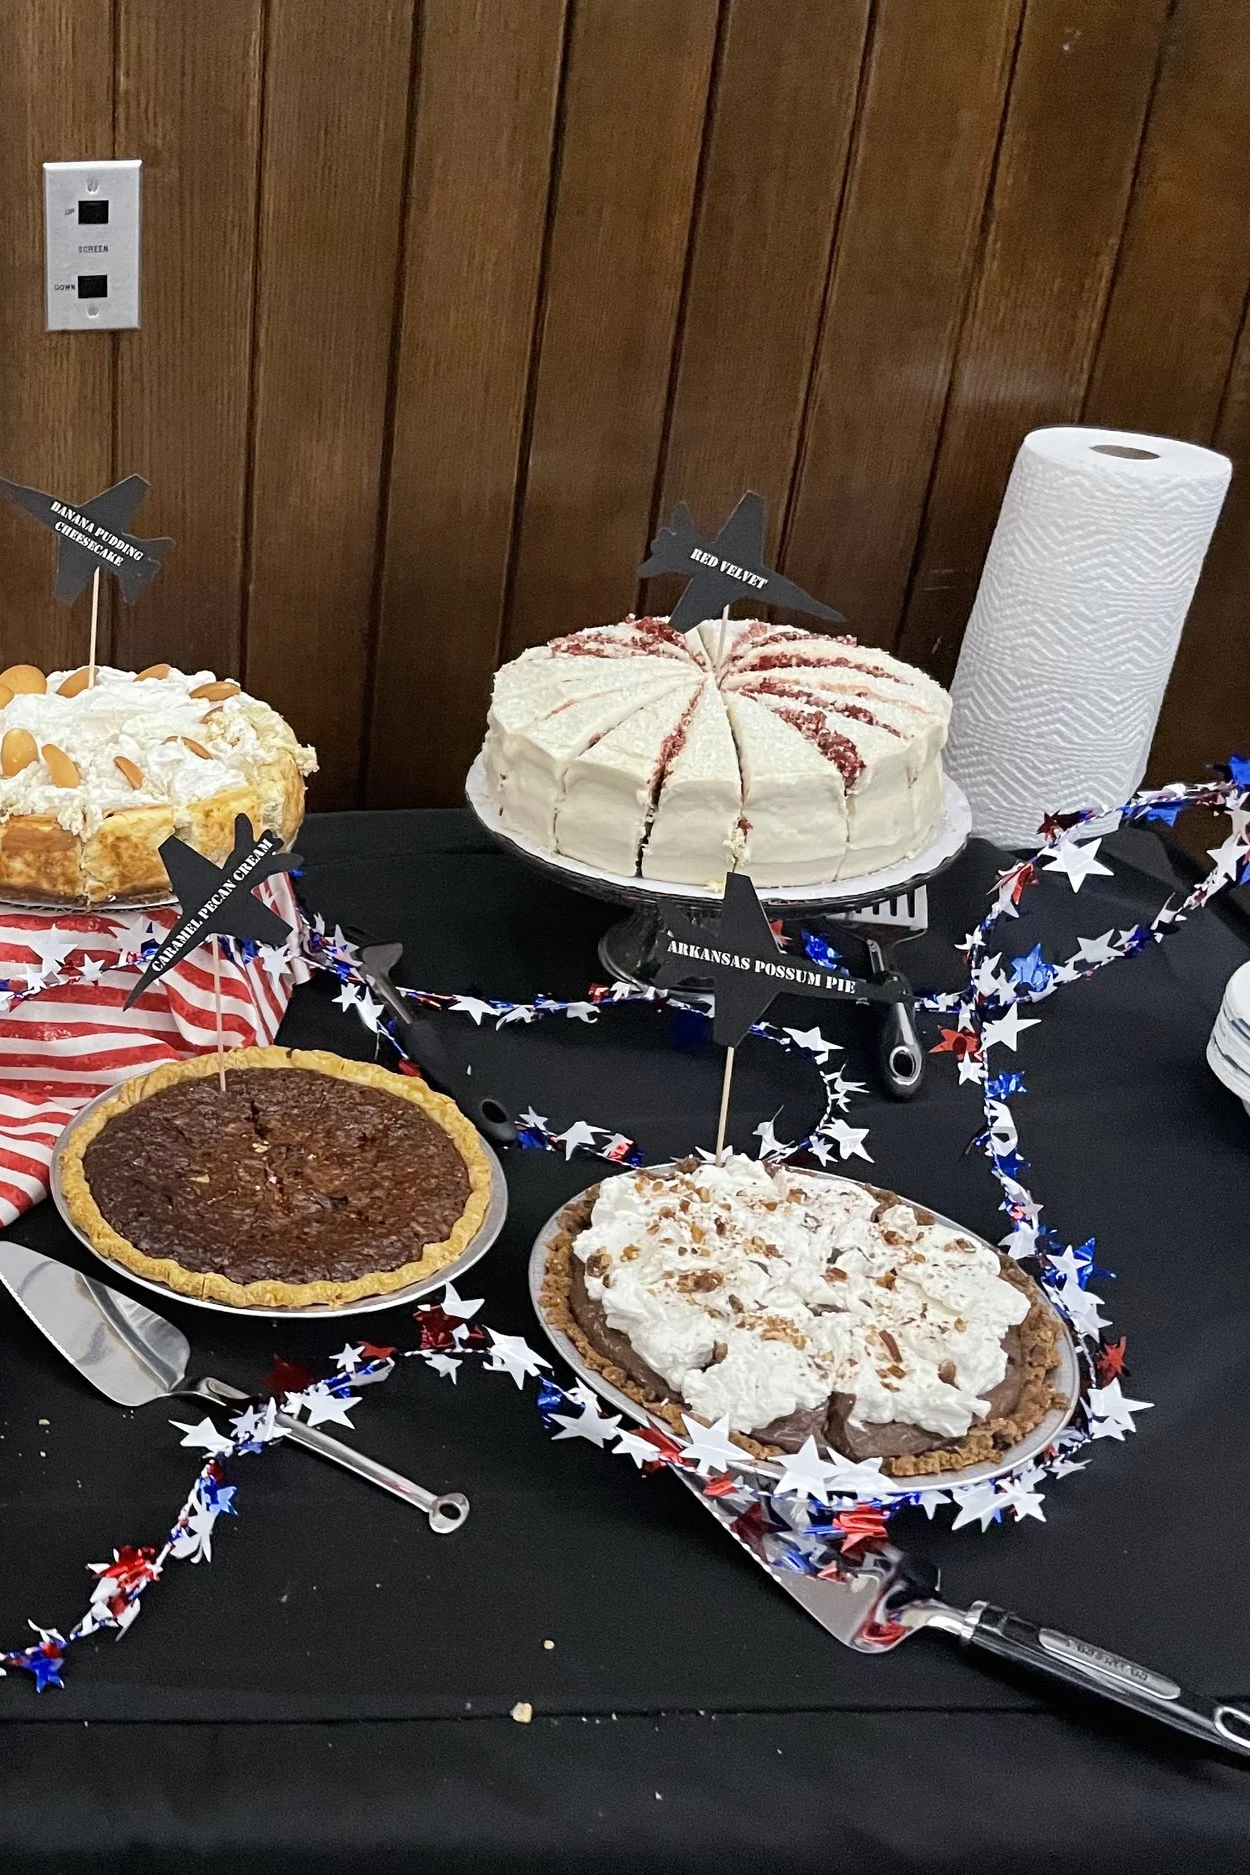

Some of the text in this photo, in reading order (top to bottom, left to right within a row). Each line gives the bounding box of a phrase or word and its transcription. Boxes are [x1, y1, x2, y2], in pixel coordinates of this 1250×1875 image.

[78, 245, 109, 253] SCREEN
[50, 500, 144, 562] BANANA PUDDING
[54, 520, 125, 567] CHEESECAKE
[690, 548, 768, 589] RED VELVET
[151, 837, 273, 973] CARAMEL PECAN CREAM
[667, 940, 856, 995] ARKANSAS POSSUM PIE
